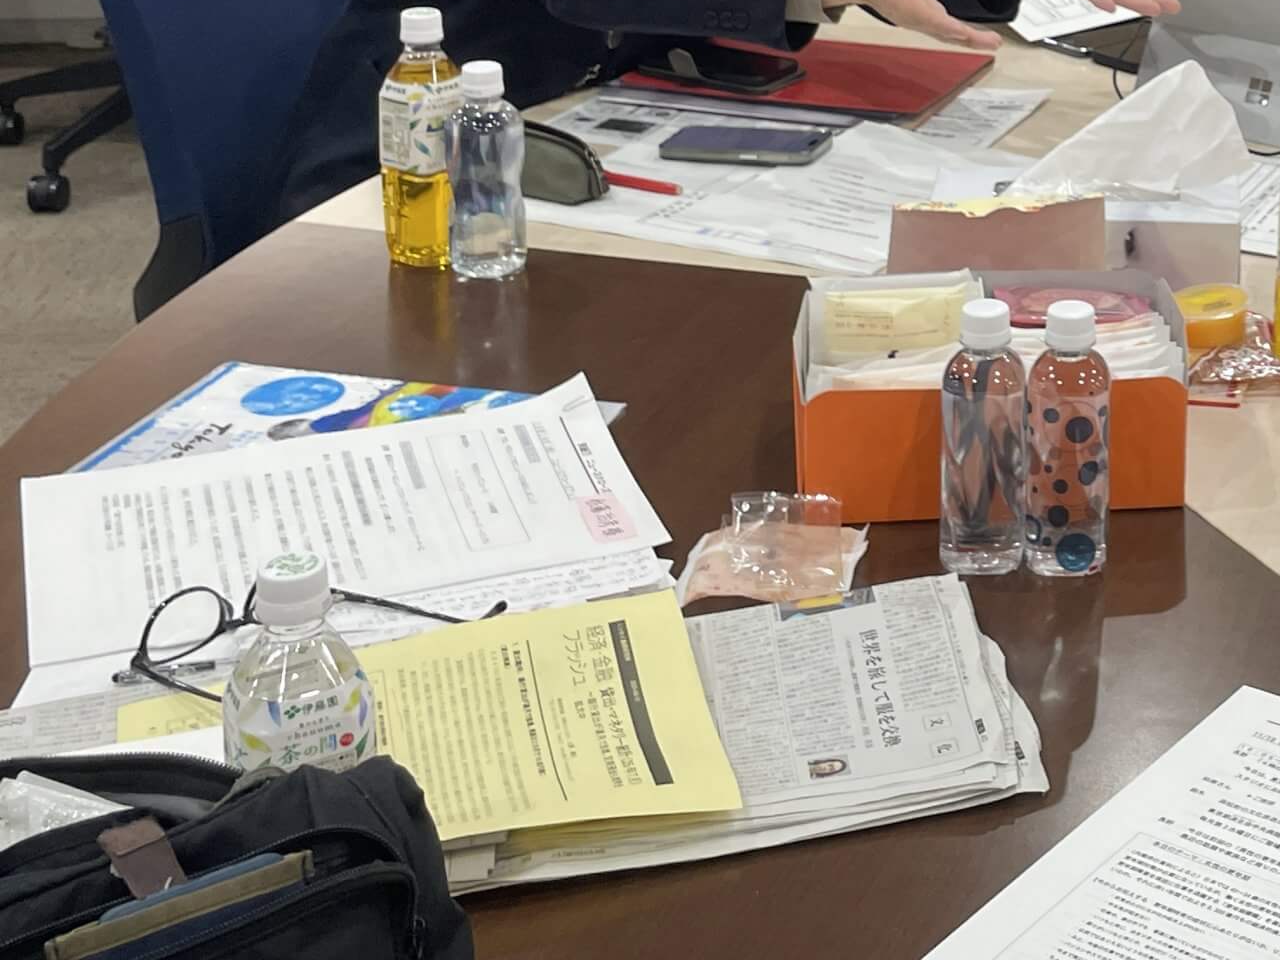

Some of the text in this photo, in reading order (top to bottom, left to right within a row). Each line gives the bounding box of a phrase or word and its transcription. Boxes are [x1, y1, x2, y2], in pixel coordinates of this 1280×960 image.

[556, 629, 596, 686] フラッシュ
[279, 734, 338, 766] 茶の間
